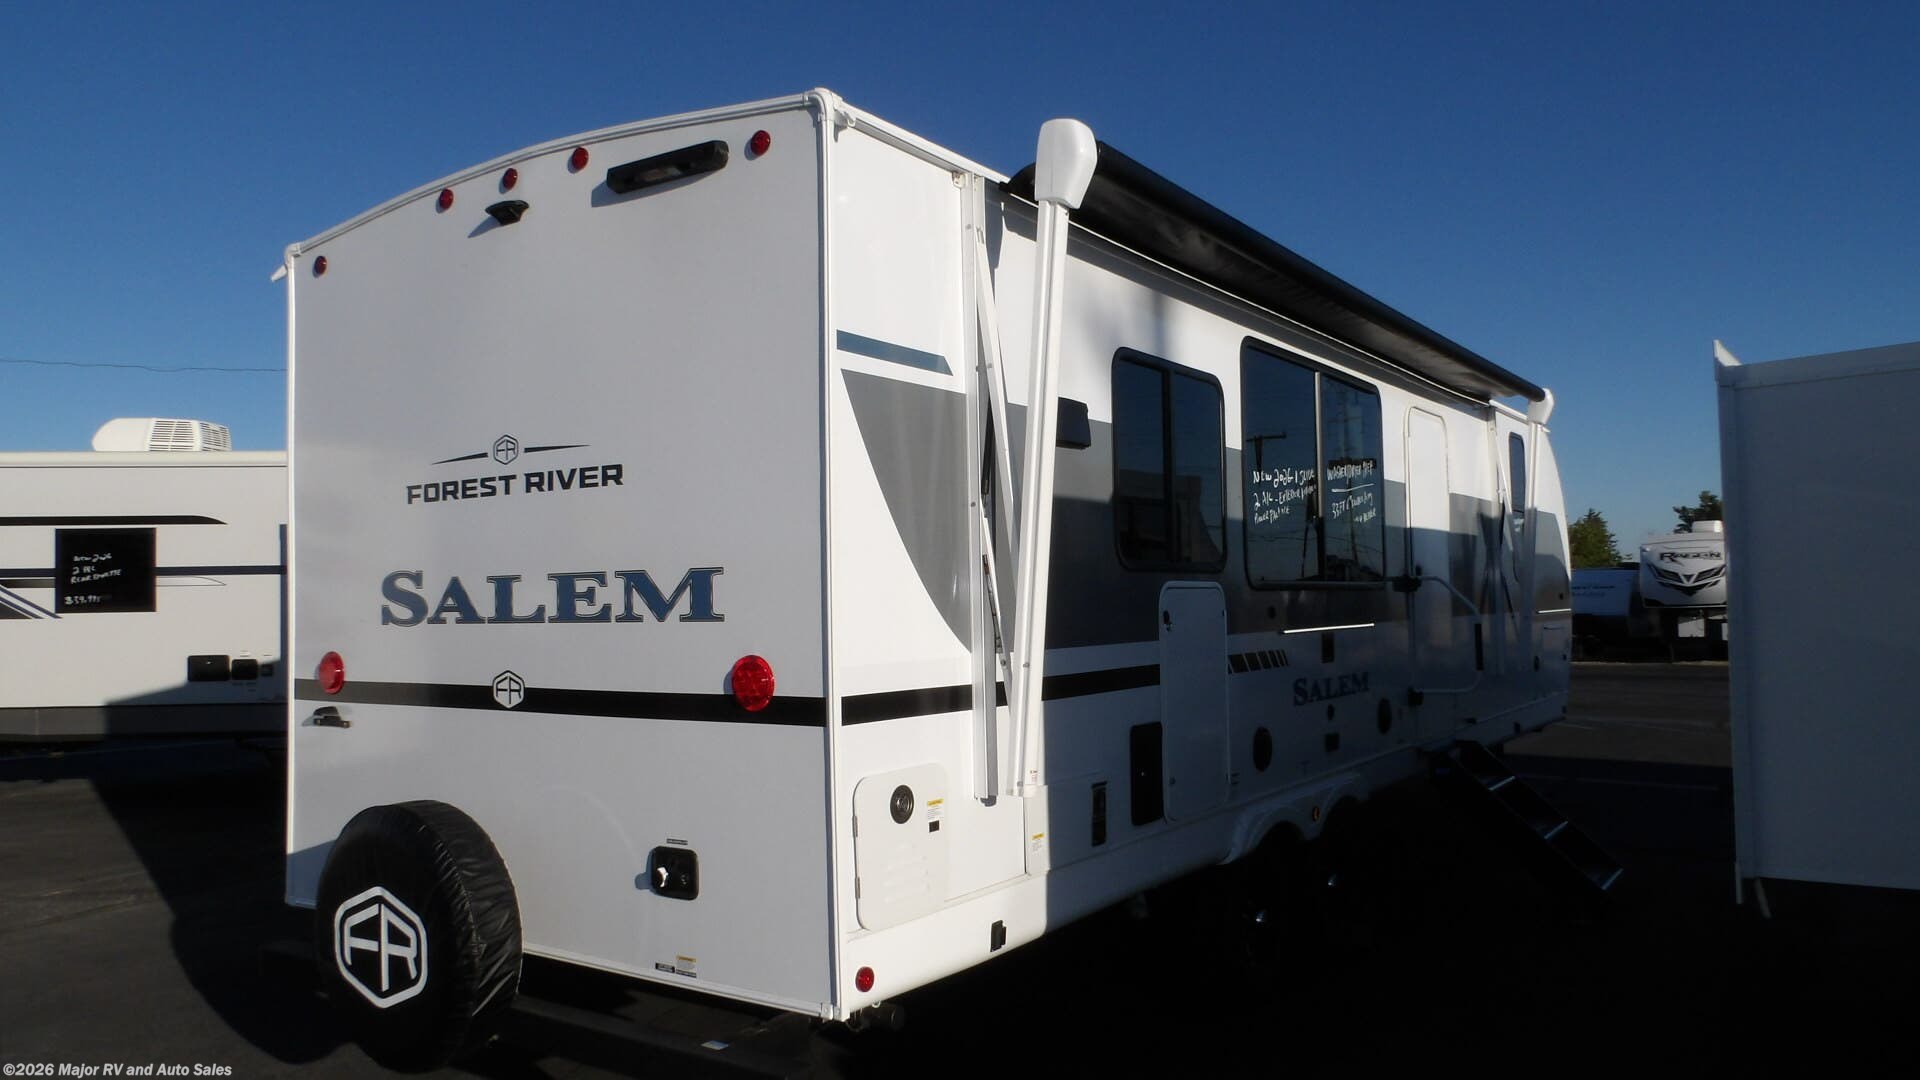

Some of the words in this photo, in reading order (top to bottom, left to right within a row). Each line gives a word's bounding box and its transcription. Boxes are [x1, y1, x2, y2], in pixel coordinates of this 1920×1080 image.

[406, 473, 517, 505] FOREST
[523, 463, 625, 494] RIVER
[380, 566, 726, 628] SALEM
[1293, 671, 1371, 707] SALEM
